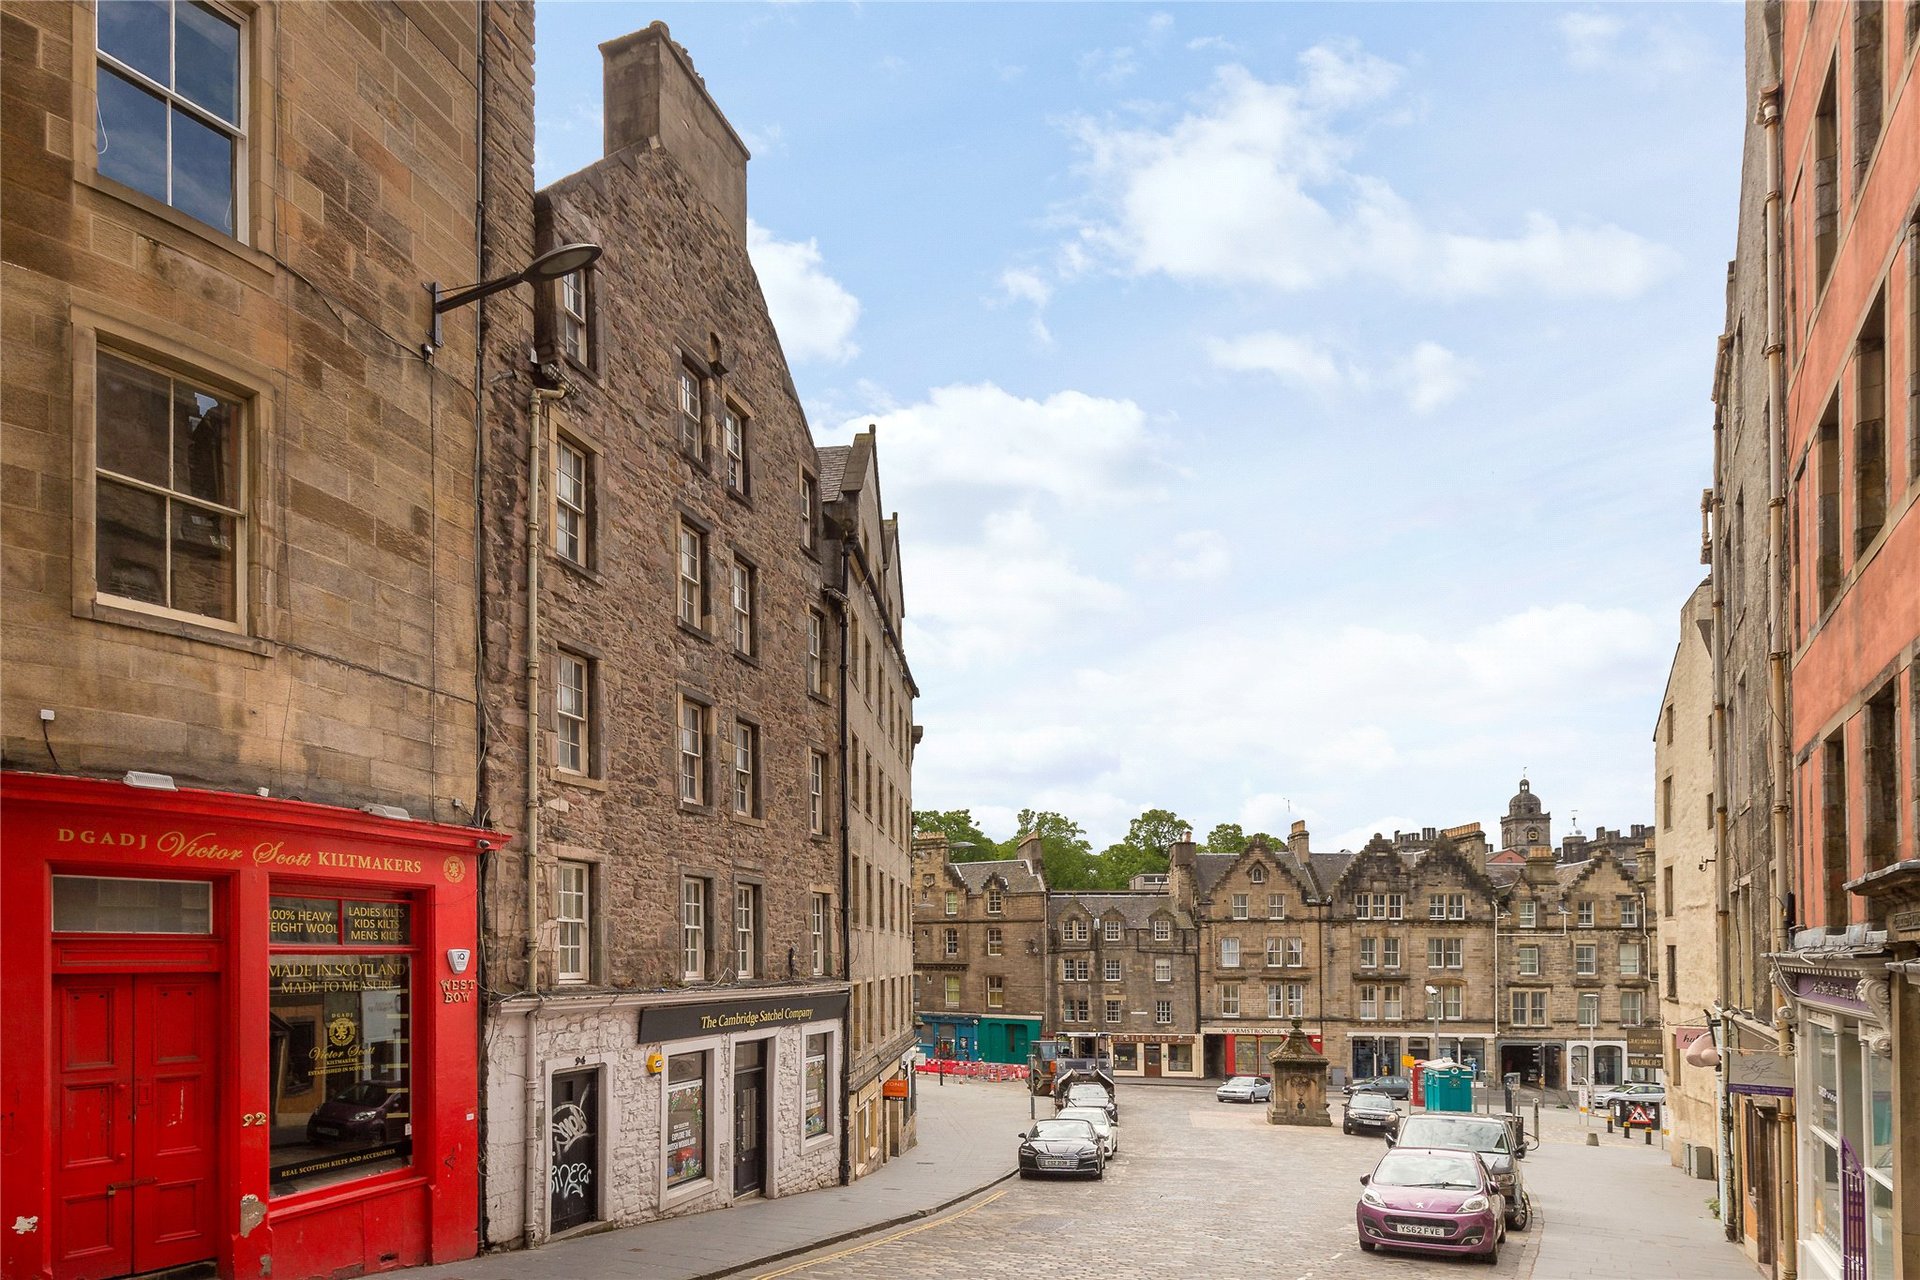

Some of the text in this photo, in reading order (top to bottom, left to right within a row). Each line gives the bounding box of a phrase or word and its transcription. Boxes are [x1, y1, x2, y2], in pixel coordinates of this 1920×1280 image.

[58, 828, 147, 850] DGADJ
[157, 831, 243, 860] Victor
[252, 841, 312, 868] Scott
[318, 851, 422, 873] KILTMAKERS
[298, 911, 332, 922] HEAVY
[348, 906, 405, 918] LADIES KILTS
[269, 922, 338, 934] EIGHT WOOL
[354, 919, 400, 929] KIDS KILTS
[351, 930, 403, 941] MENS KILTS
[269, 963, 406, 977] MADE IN SCOTLAND
[281, 980, 393, 993] MADE TO MEASURE
[441, 979, 475, 991] WEST
[444, 991, 470, 1003] BOW
[701, 1007, 814, 1029] The Cambridge Satchel Company
[308, 1044, 375, 1060] Victor Scott
[575, 1056, 586, 1065] 96
[1630, 1058, 1661, 1067] VACANCIES
[242, 1112, 267, 1127] 92
[281, 1168, 298, 1177] REAL
[299, 1162, 330, 1173] SCOTTISH
[331, 1158, 348, 1167] KILTS
[349, 1155, 362, 1163] AND
[1401, 1225, 1441, 1236] YS62 FVE
